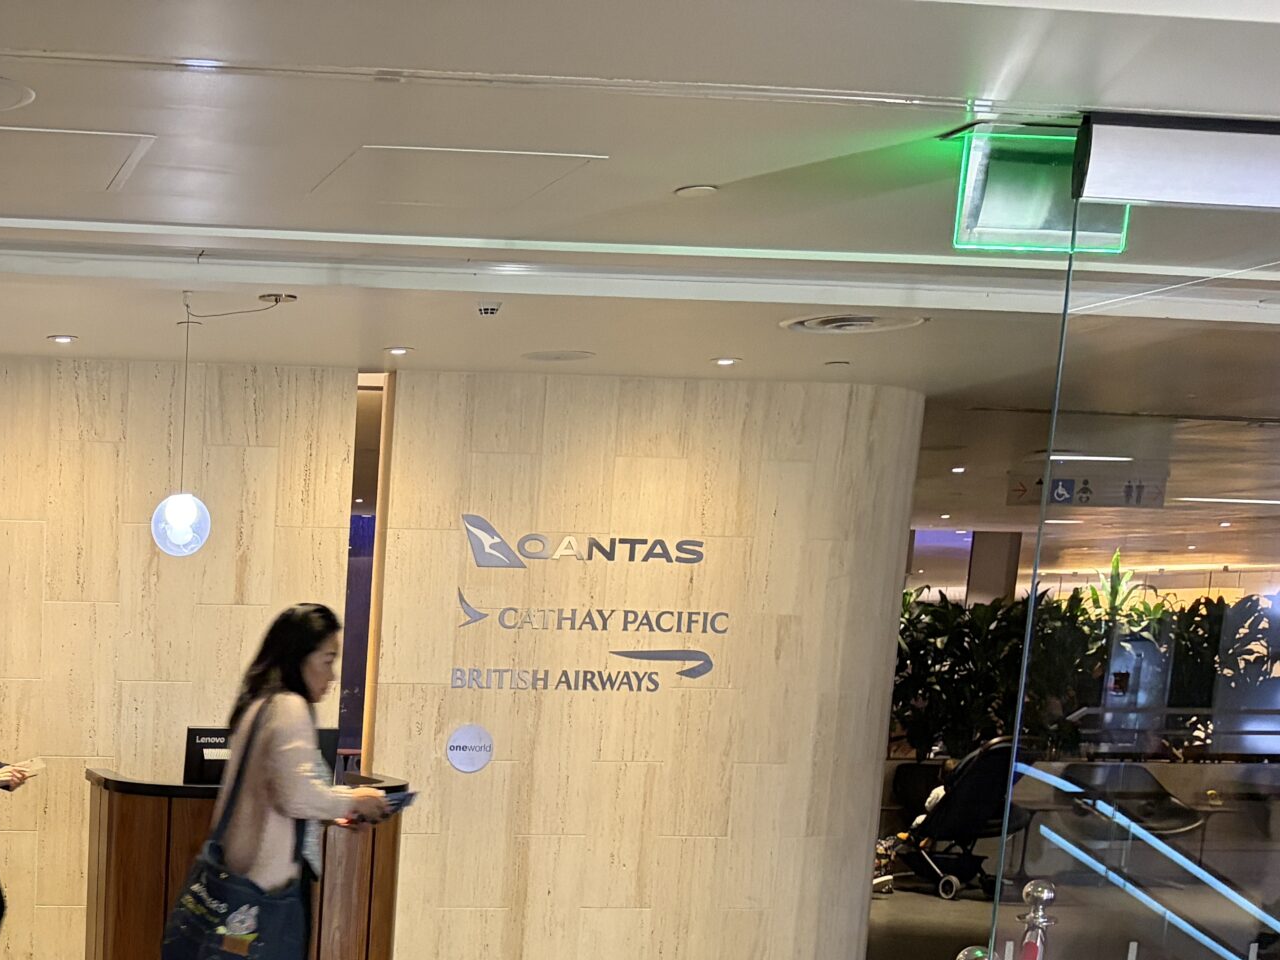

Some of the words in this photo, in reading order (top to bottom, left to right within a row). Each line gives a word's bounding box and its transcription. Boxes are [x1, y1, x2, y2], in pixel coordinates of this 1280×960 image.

[517, 533, 705, 564] QANTAS
[498, 607, 616, 631] CATHAY
[622, 609, 729, 634] PACIFIC
[451, 667, 549, 690] BRITISH
[555, 670, 660, 692] AIRWAYS
[195, 735, 225, 743] Lenovo
[449, 744, 492, 752] oneworld
